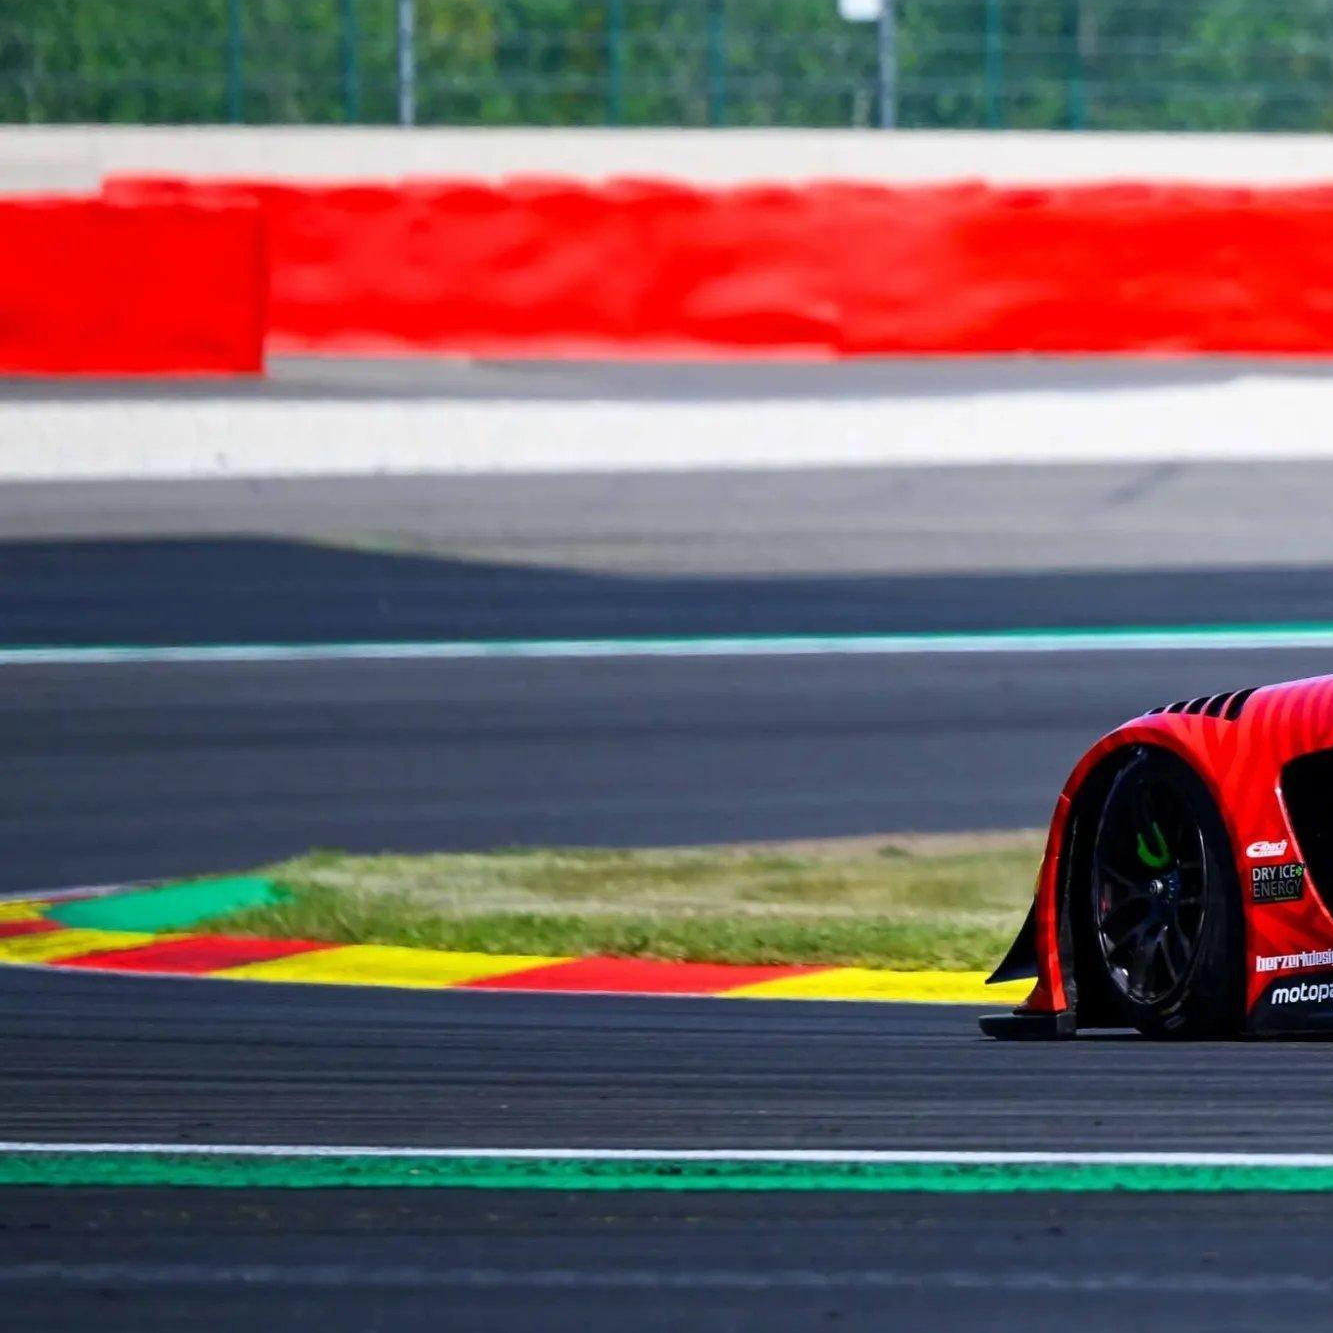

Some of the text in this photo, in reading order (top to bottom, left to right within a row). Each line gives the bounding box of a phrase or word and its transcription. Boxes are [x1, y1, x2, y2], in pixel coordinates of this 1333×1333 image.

[1252, 864, 1296, 881] DRY ICE
[1253, 879, 1302, 898] ENERGY
